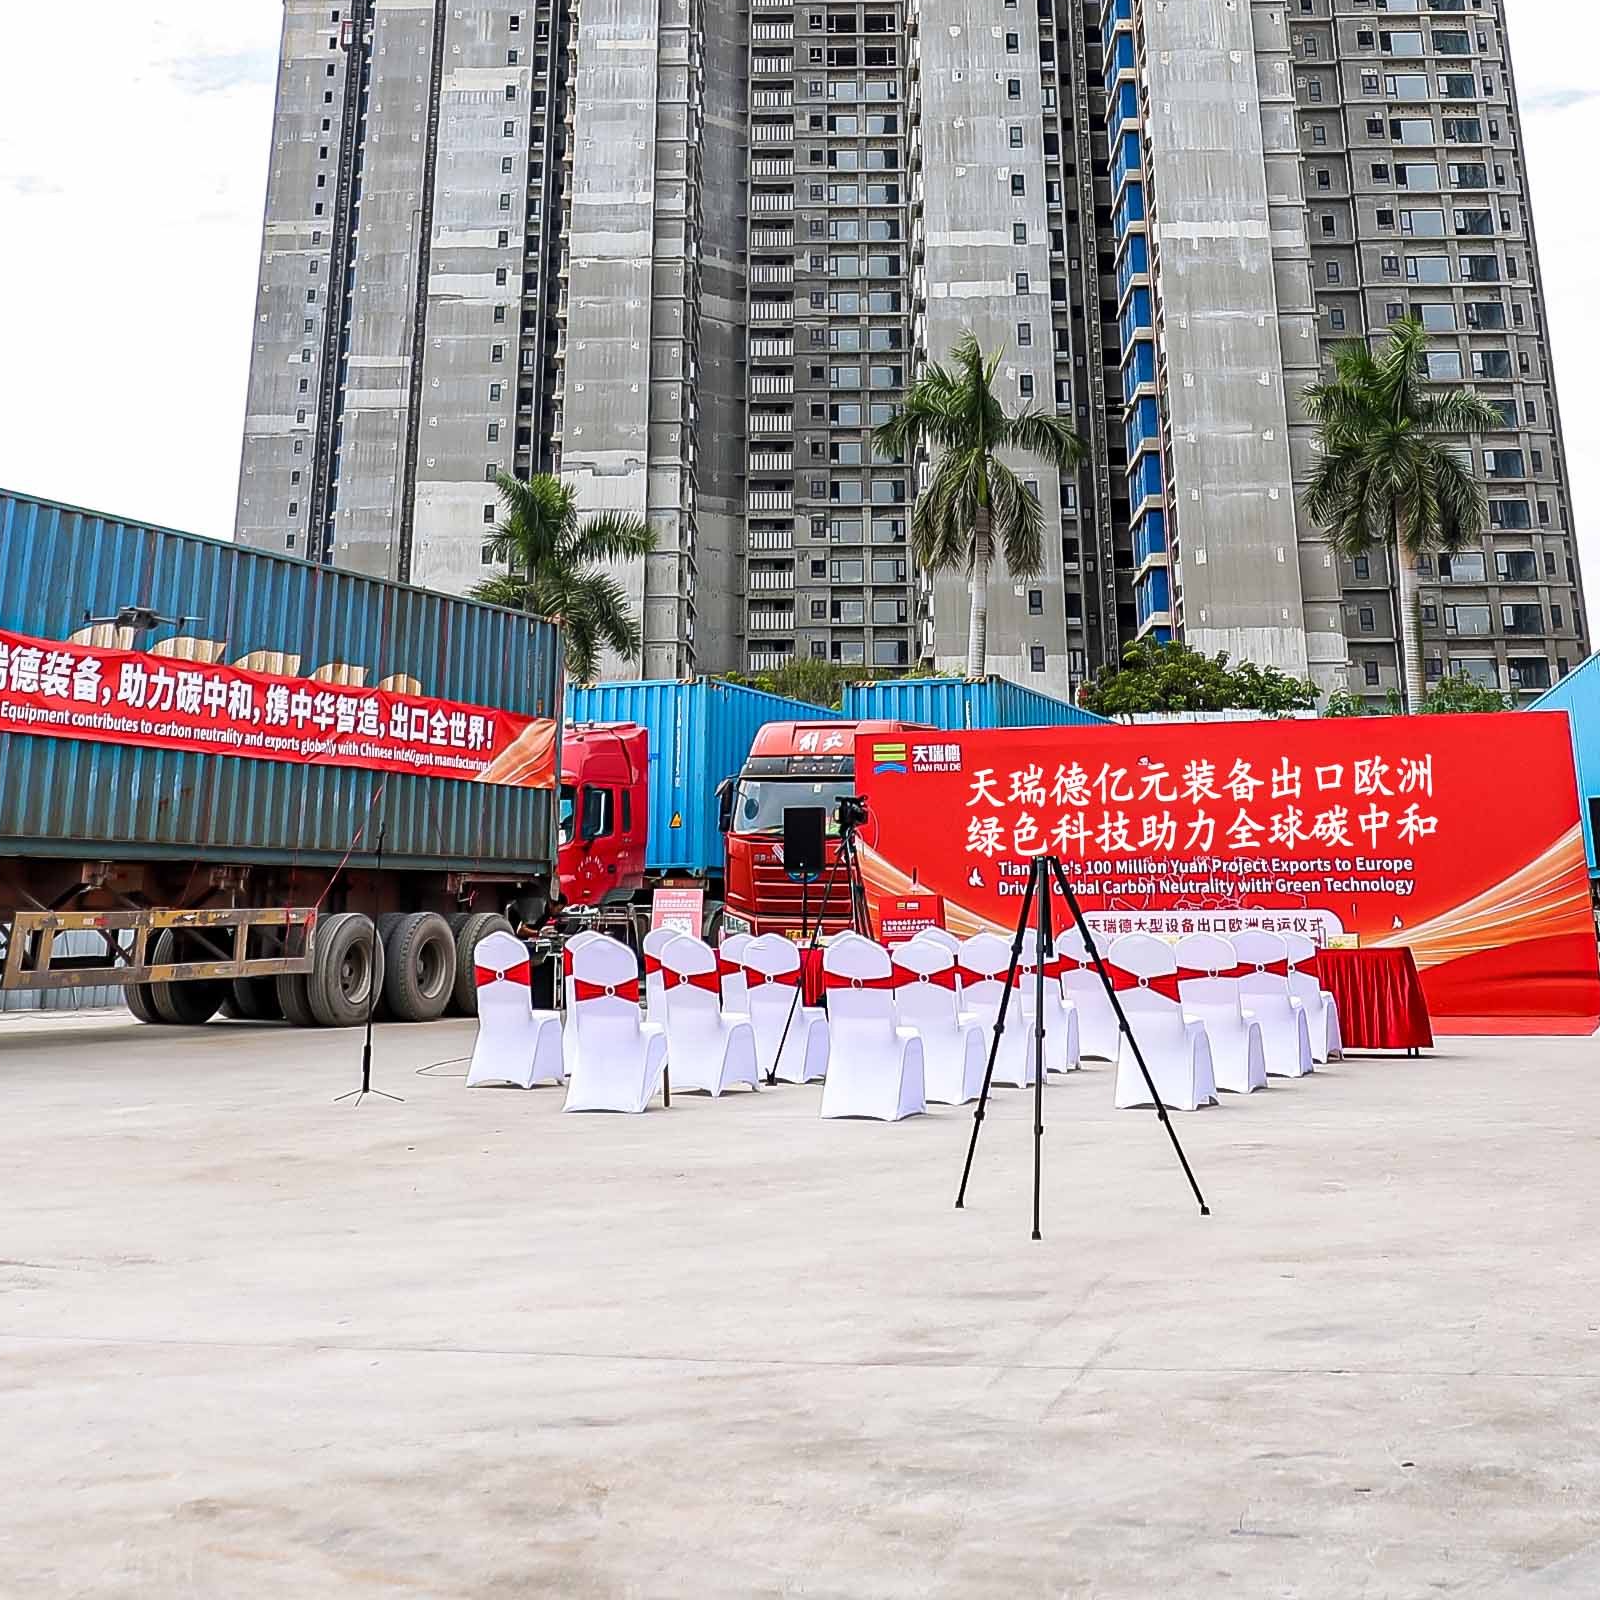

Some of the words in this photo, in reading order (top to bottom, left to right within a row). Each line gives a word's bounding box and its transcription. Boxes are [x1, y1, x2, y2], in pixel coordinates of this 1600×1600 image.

[0, 703, 69, 725] Equipment
[71, 711, 138, 732] contributes
[140, 718, 152, 734] to
[154, 719, 192, 738] carbon
[193, 728, 243, 748] neutrality
[244, 733, 263, 746] and
[265, 736, 299, 751] exports
[338, 741, 359, 755] with
[360, 743, 393, 758] Chinese
[912, 744, 960, 762] 天瑞德
[934, 763, 948, 771] RUI
[950, 763, 961, 771] DE
[966, 753, 1433, 808] 天瑞德亿元装备出口欧洲
[965, 802, 1439, 858] 绿色科技助力全球碳中和
[1085, 860, 1112, 874] 100
[1116, 860, 1167, 874] Million
[1170, 860, 1207, 874] Yuan
[1212, 858, 1267, 876] Project
[1272, 858, 1331, 876] Exports
[1335, 858, 1352, 871] to
[1356, 857, 1413, 875] Europe
[1103, 880, 1155, 895] Carbon
[1160, 878, 1234, 896] Neutrality
[1238, 877, 1271, 893] with
[1276, 878, 1321, 892] Green
[1324, 876, 1414, 896] Technology
